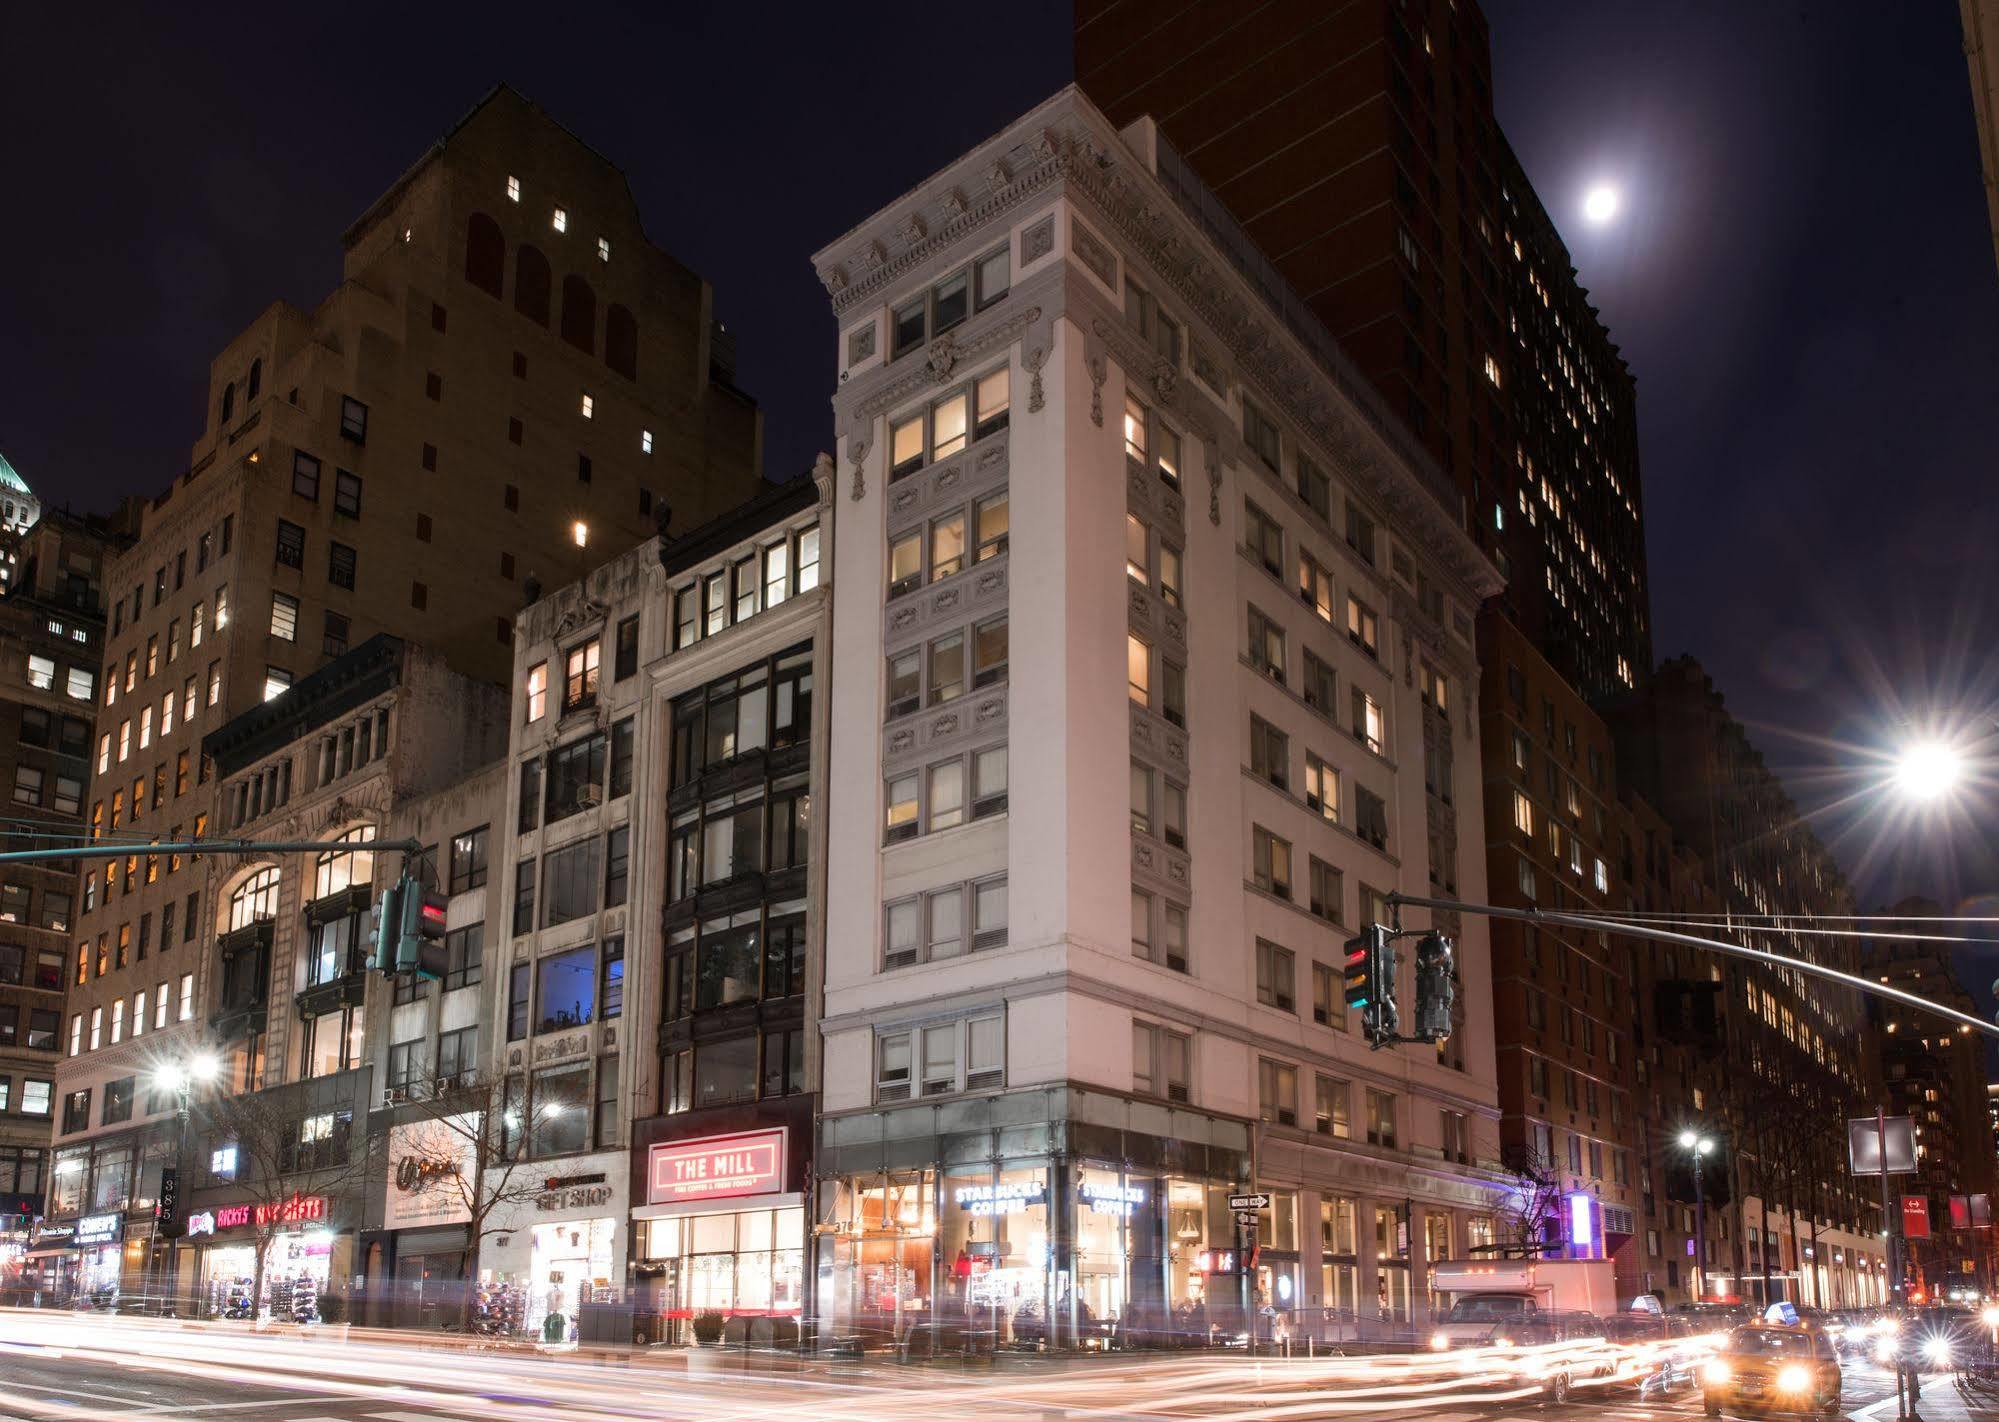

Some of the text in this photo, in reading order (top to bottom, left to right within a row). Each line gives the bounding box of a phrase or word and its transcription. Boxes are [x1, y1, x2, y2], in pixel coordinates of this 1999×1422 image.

[674, 1153, 754, 1180] THE MILL
[161, 1179, 175, 1220] 385
